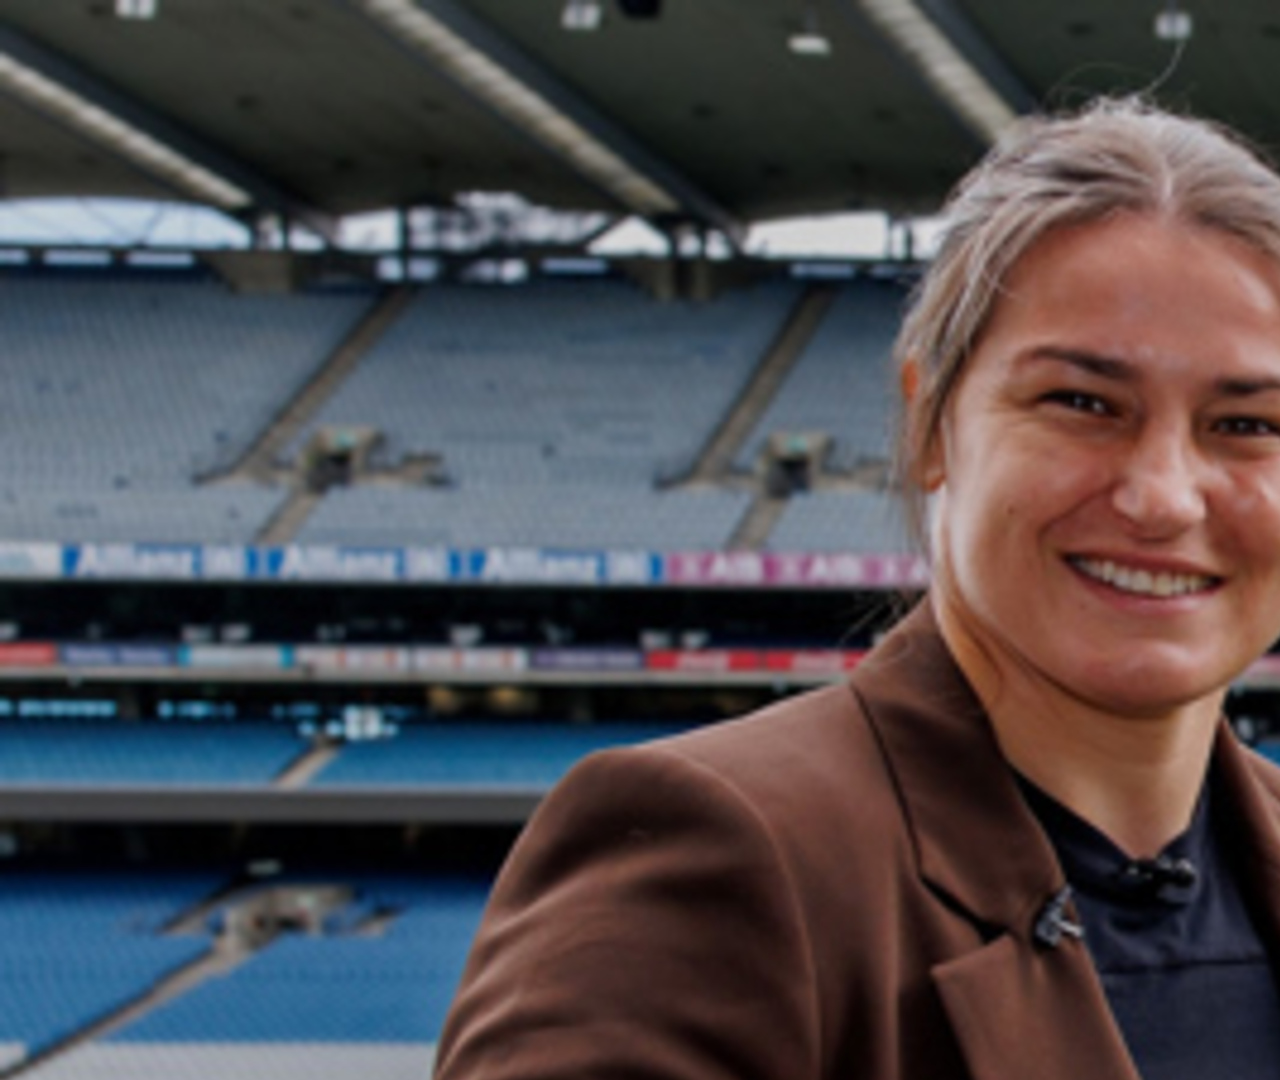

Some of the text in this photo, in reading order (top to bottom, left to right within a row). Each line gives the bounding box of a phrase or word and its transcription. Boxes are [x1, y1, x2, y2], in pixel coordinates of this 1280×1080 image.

[79, 546, 195, 578] Allianz
[280, 547, 397, 579] Allianz
[481, 549, 599, 582] Allianz
